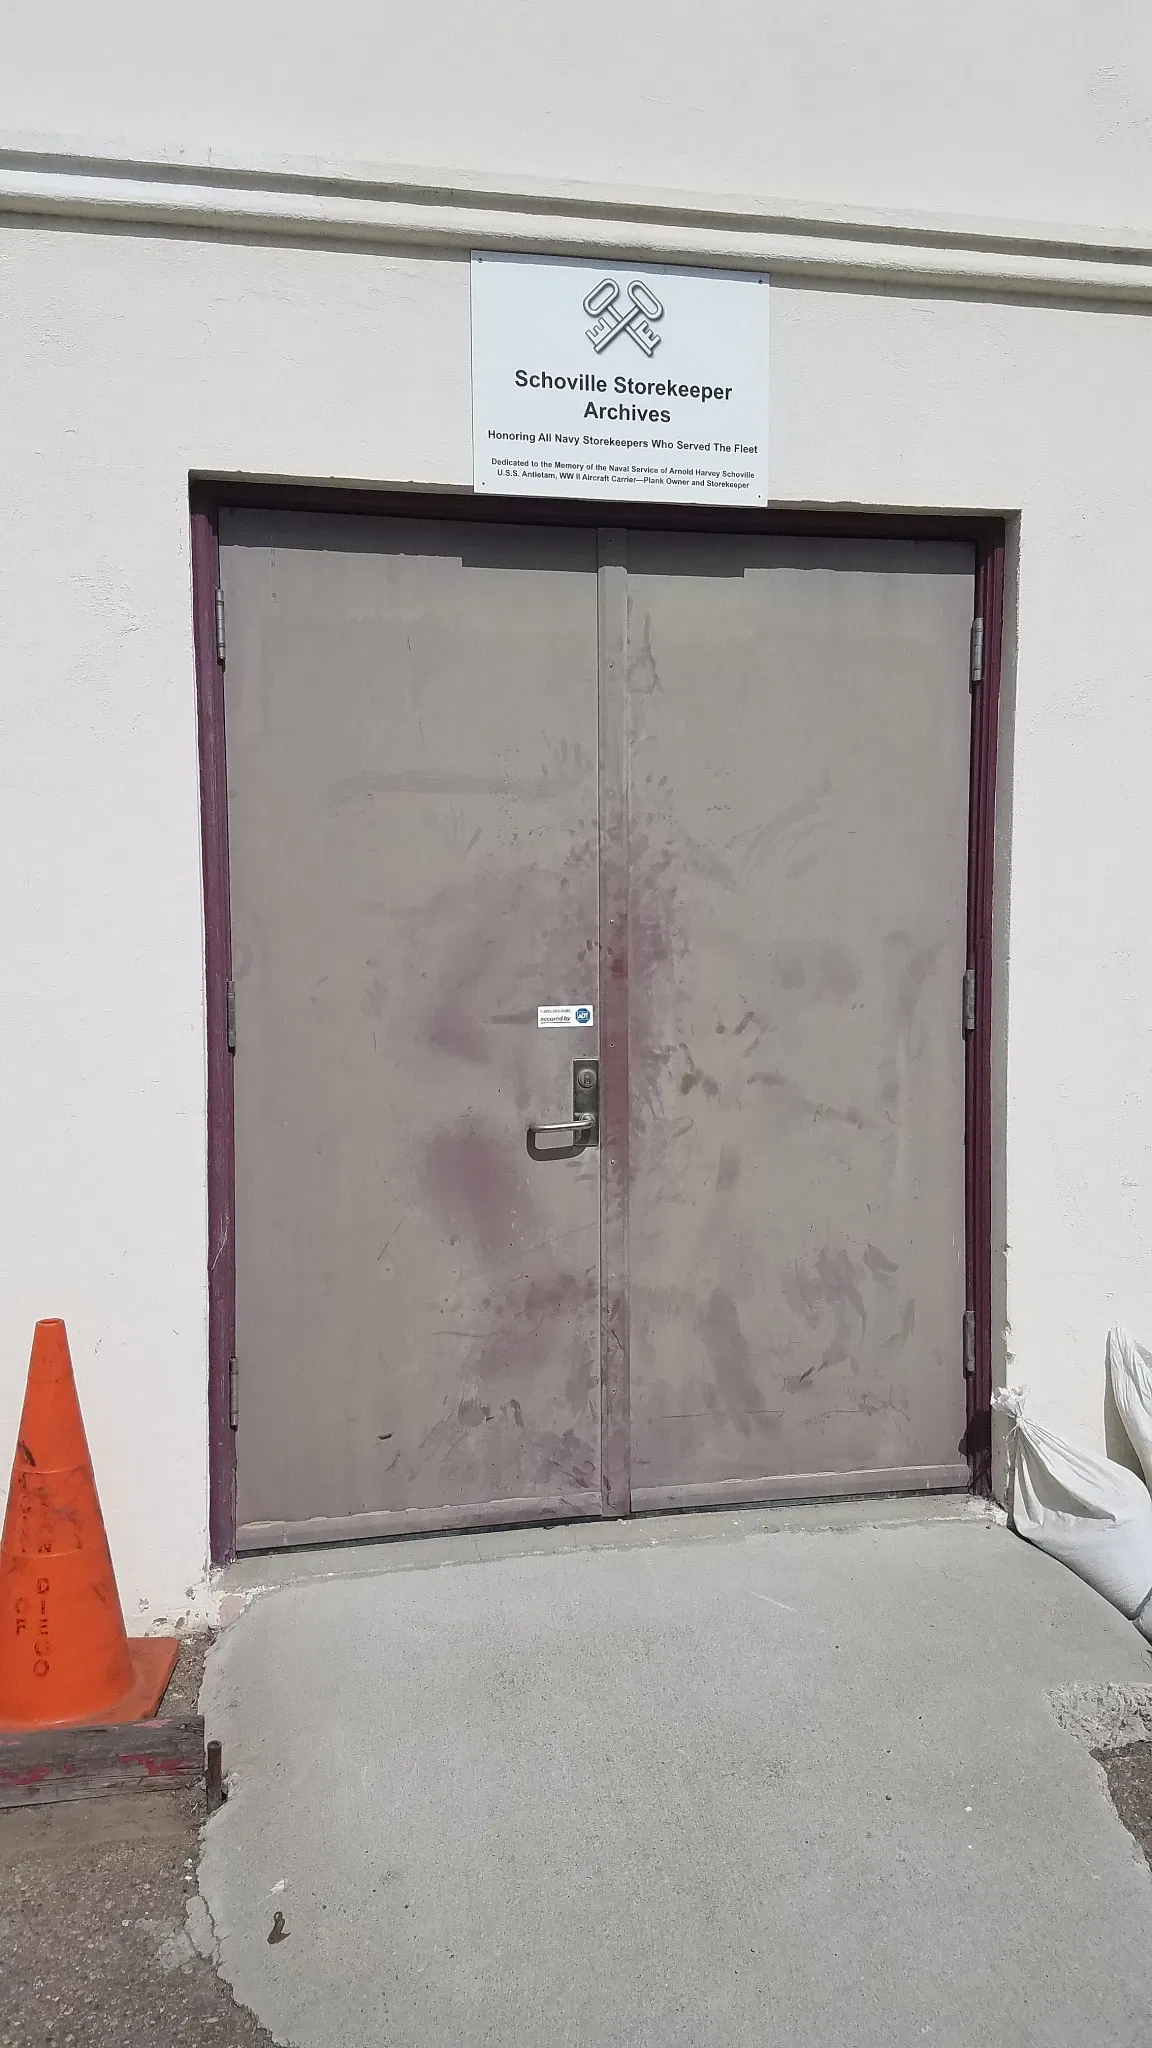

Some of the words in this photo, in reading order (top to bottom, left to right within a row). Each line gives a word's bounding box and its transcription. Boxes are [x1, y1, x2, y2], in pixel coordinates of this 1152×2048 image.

[514, 369, 608, 393] Schoville
[613, 376, 733, 403] Storekeeper
[583, 401, 671, 423] Archives
[488, 429, 536, 444] Honoring
[537, 432, 552, 442] All
[554, 433, 580, 446] Navy
[582, 435, 649, 449] Storekeepers
[651, 439, 674, 449] Who
[676, 440, 711, 452] Served
[713, 442, 732, 453] The
[734, 443, 758, 454] Fleet
[491, 457, 529, 467] Dedicated
[531, 460, 539, 468] to
[540, 460, 553, 468] the
[554, 461, 585, 472] Memory
[585, 463, 594, 471] of
[595, 464, 607, 472] the
[608, 464, 630, 473] Naval
[631, 465, 659, 474] Service
[668, 467, 694, 476] Arnold
[695, 468, 721, 479] Harvey
[722, 470, 755, 479] Schoville
[497, 468, 520, 477] U.S.S.
[521, 470, 558, 480] Antietam,
[559, 472, 575, 480] WW
[575, 473, 582, 481] II
[582, 473, 610, 482] Aircraft
[665, 477, 690, 486] Owner
[691, 479, 705, 487] and
[706, 479, 750, 490] Storekeeper
